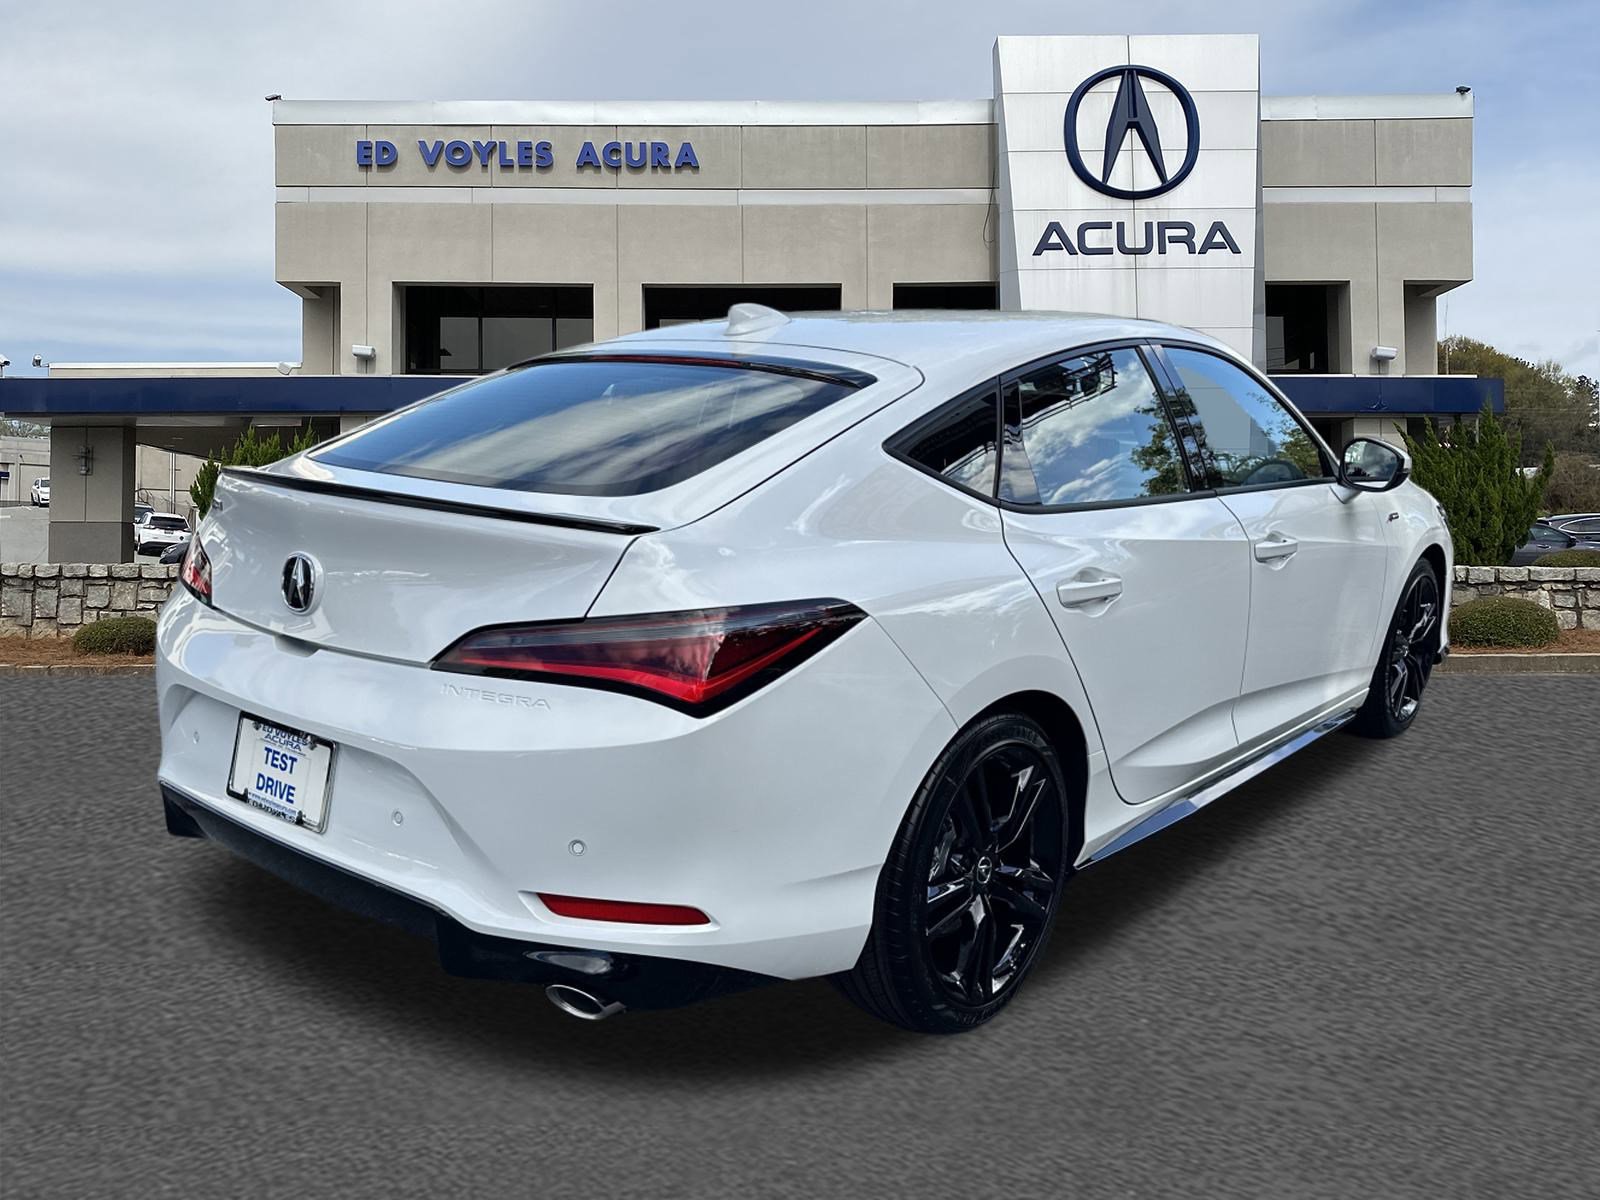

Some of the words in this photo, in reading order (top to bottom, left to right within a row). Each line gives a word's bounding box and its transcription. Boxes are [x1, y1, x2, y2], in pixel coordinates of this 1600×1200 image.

[356, 139, 398, 167] ED
[418, 139, 554, 168] VOYLES
[576, 141, 700, 168] ACURA
[1032, 221, 1242, 256] ACURA
[441, 683, 551, 711] INTEGRA
[264, 733, 302, 751] ACURA
[264, 746, 298, 774] TEST
[256, 772, 296, 804] DRIVE
